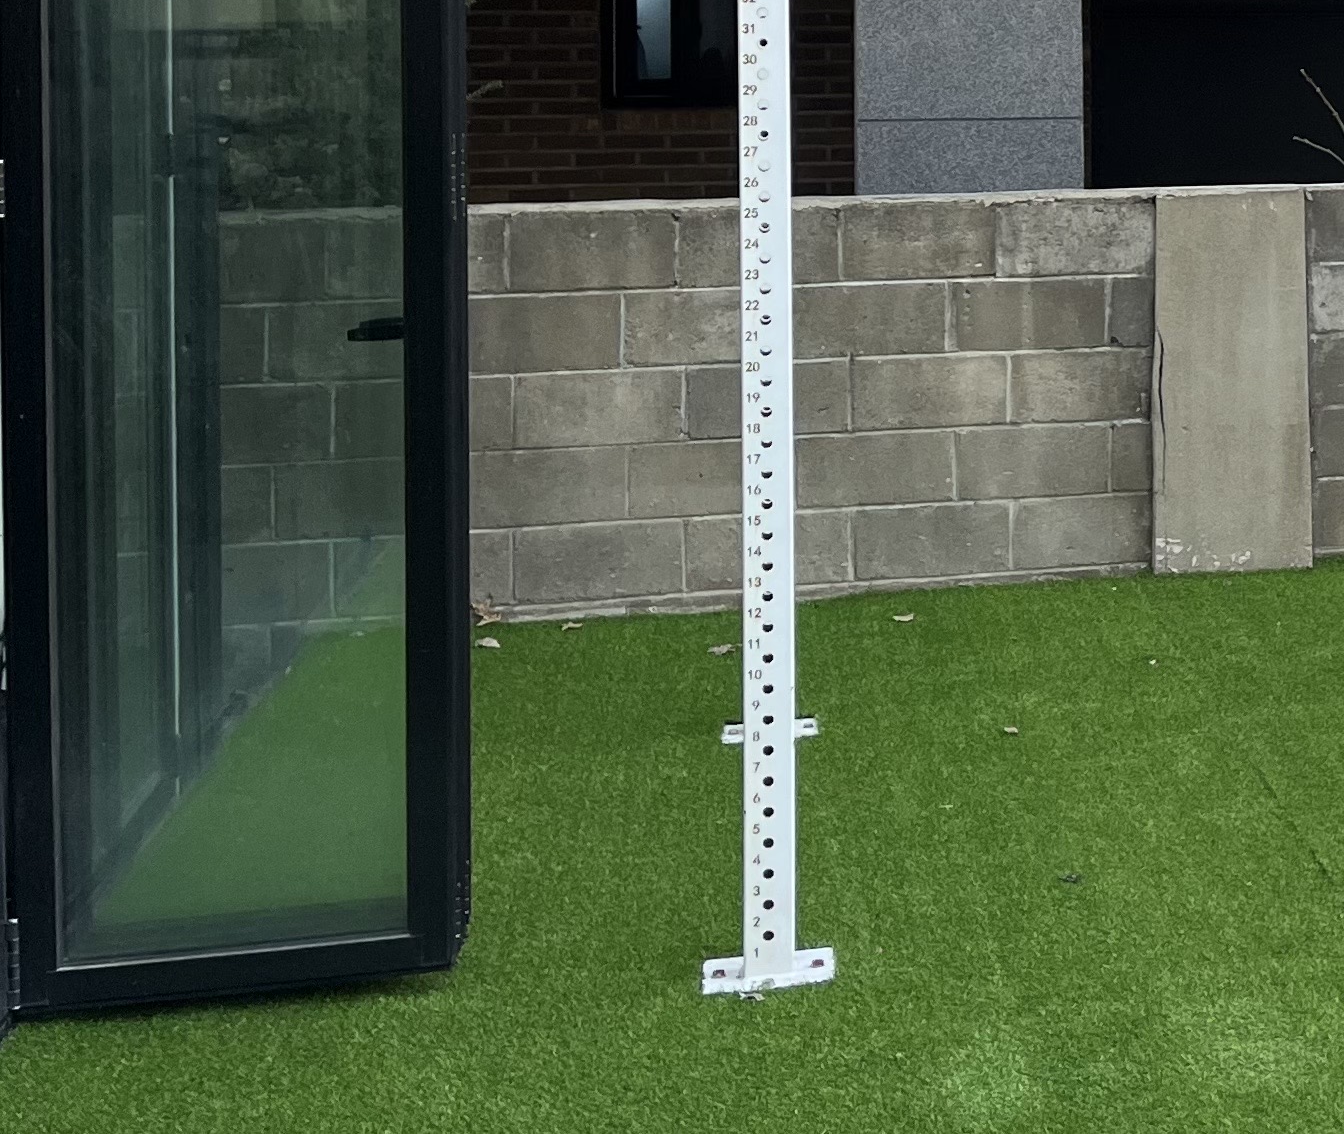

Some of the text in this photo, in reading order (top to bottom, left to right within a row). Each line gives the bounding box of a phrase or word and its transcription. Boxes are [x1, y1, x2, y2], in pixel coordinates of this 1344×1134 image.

[742, 24, 754, 34] 31
[742, 54, 758, 64] 30
[742, 84, 758, 96] 29
[742, 116, 758, 126] 28
[744, 146, 758, 158] 27
[744, 176, 758, 188] 26
[744, 208, 758, 218] 25
[744, 238, 758, 250] 24
[744, 268, 760, 280] 23
[744, 300, 760, 310] 22
[745, 330, 758, 342] 21
[745, 362, 760, 372] 20
[746, 392, 760, 404] 19
[747, 424, 760, 434] 18
[747, 454, 762, 464] 17
[747, 484, 762, 496] 16
[748, 516, 762, 526] 15
[748, 546, 762, 556] 14
[748, 576, 762, 588] 13
[748, 608, 762, 618] 12
[748, 638, 760, 650] 11
[749, 670, 762, 680] 10
[752, 700, 760, 710] 9
[752, 730, 760, 742] 8
[754, 762, 760, 772] 7
[752, 792, 760, 804] 6
[752, 824, 760, 834] 5
[752, 856, 760, 864] 4
[754, 886, 760, 896] 3
[754, 916, 760, 928] 2
[754, 948, 758, 958] 1
